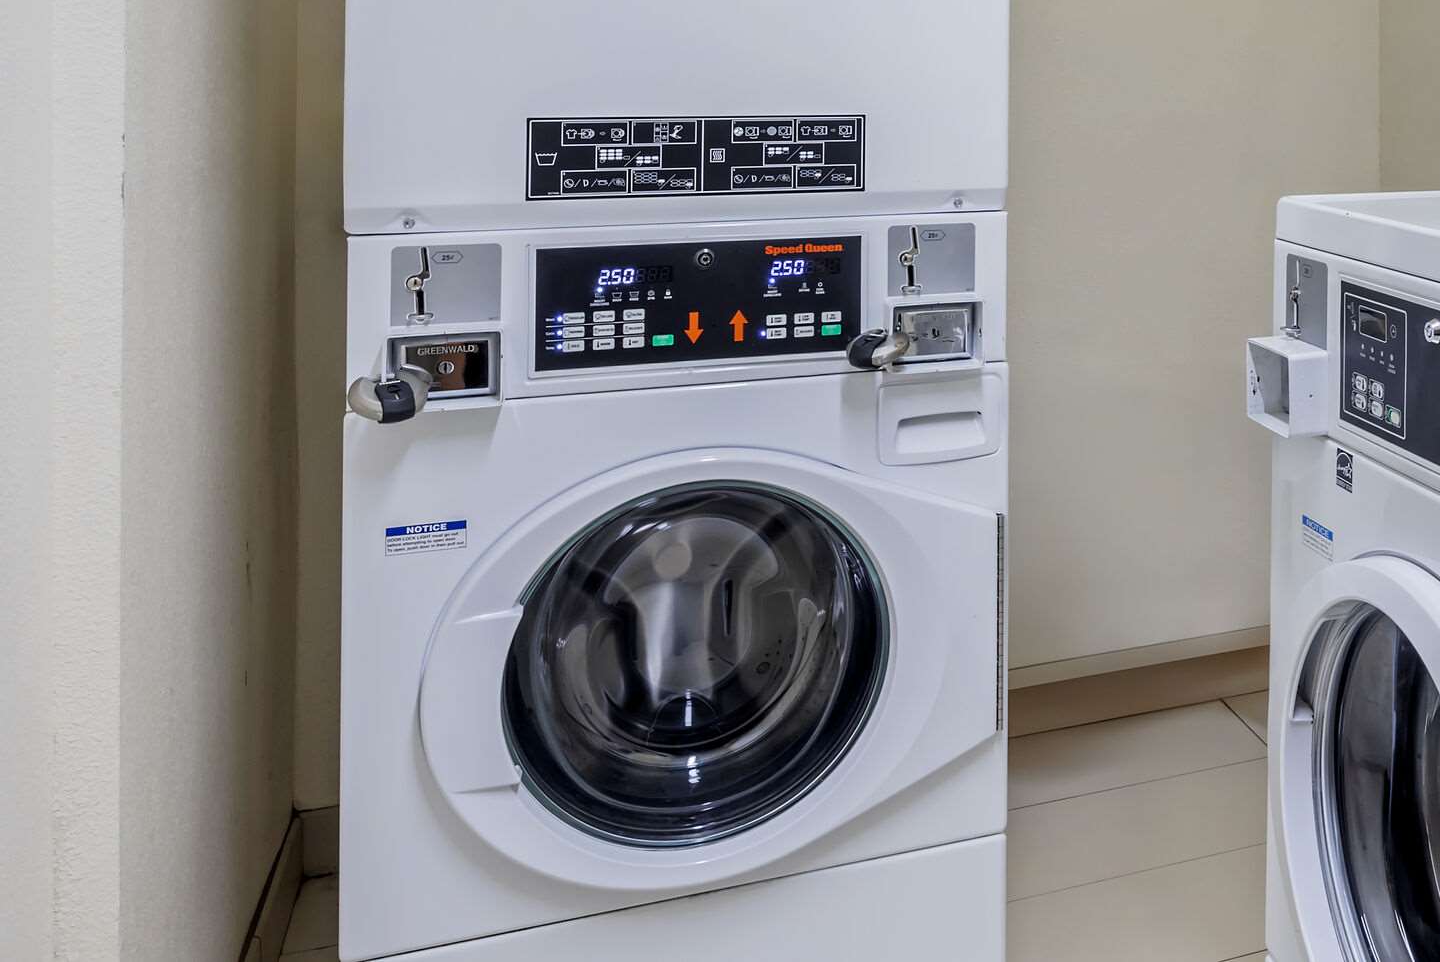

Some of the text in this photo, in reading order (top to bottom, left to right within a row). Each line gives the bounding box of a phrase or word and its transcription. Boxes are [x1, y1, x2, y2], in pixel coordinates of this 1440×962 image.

[765, 243, 843, 256] Speed Queen
[770, 259, 805, 277] 2.50
[598, 268, 635, 285] 2.50
[417, 344, 475, 356] GREENWALD
[406, 523, 447, 534] NOTICE
[1305, 518, 1330, 539] NOTICE
